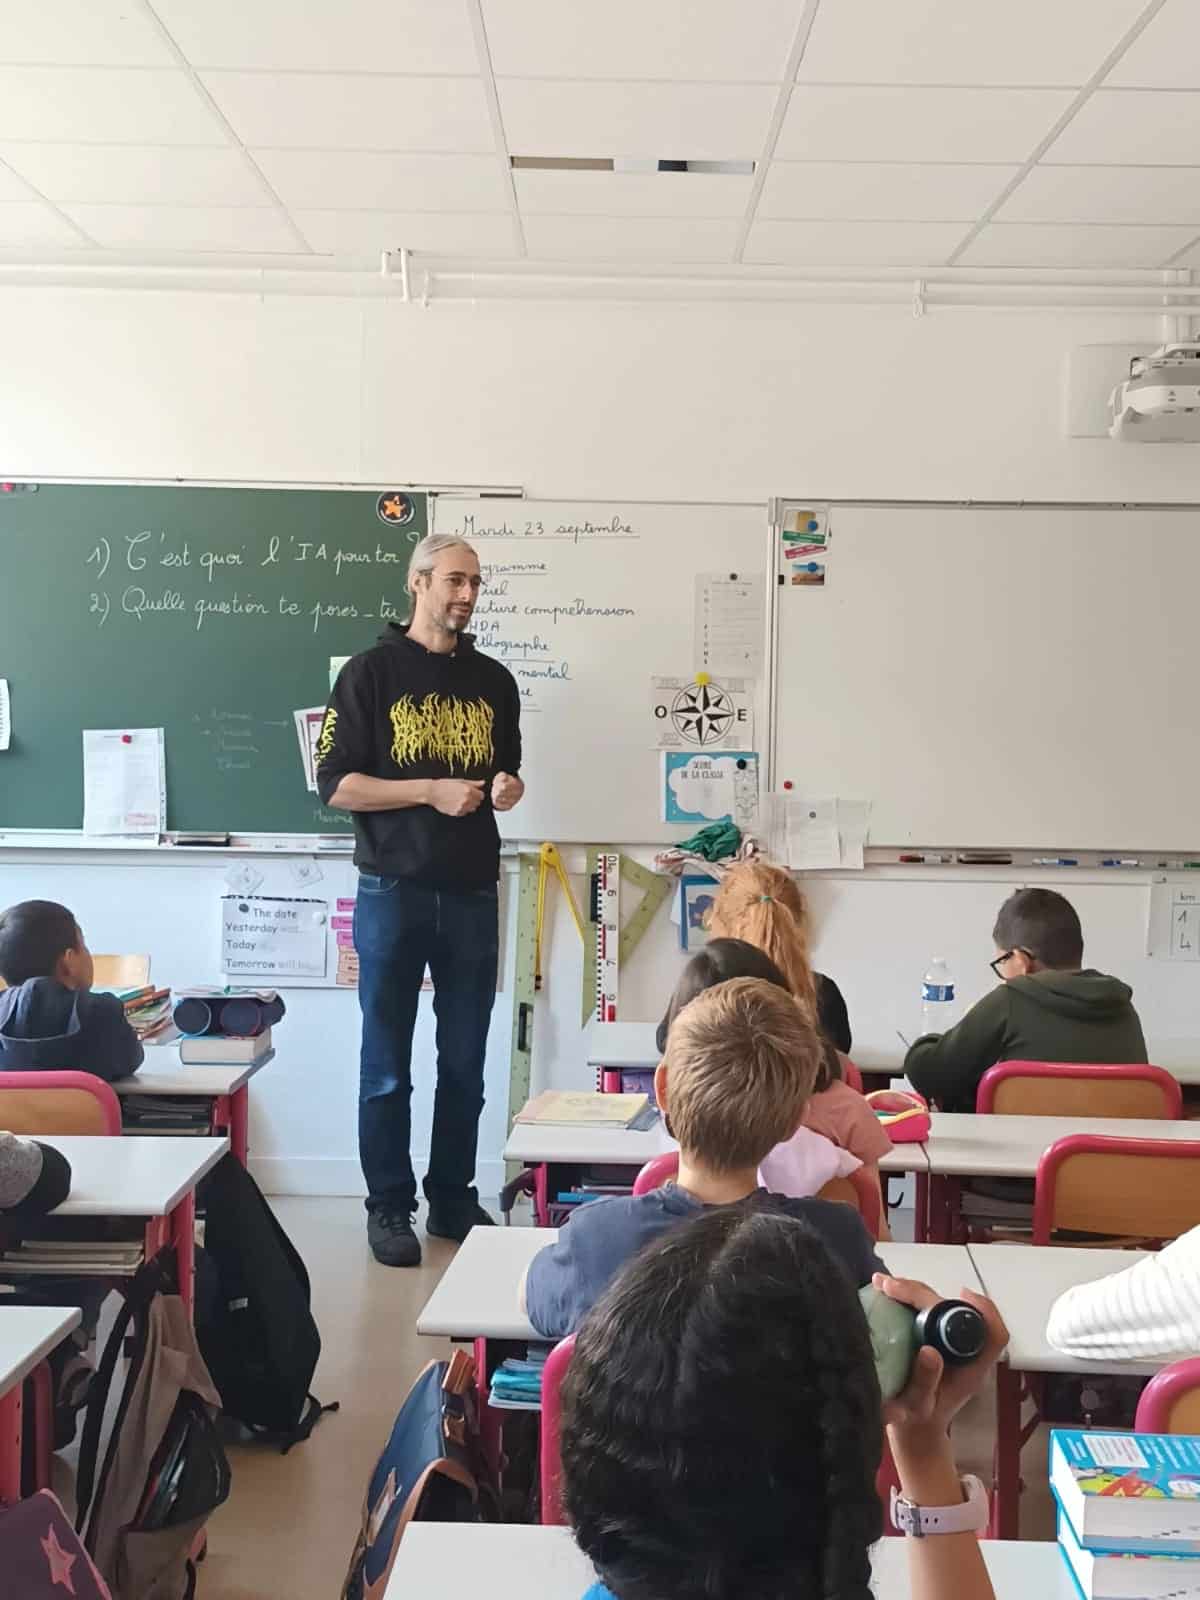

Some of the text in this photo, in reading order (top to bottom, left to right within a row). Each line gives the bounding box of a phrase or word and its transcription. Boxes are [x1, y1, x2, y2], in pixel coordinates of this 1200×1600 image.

[455, 515, 634, 544] Mardi 23 septembre
[87, 537, 110, 579] 1)
[200, 544, 244, 582] quoi
[334, 550, 371, 575] pour
[89, 592, 110, 626] 2)
[122, 586, 186, 621] Quelle
[195, 592, 269, 630] question
[279, 596, 300, 615] te
[475, 600, 518, 614] ecture
[469, 620, 500, 632] HDA
[518, 662, 573, 681] mental
[655, 705, 668, 719] O
[737, 709, 748, 721] E
[1180, 891, 1195, 900] km
[254, 908, 297, 919] The date
[225, 923, 278, 934] Yesterday
[226, 939, 256, 951] Today
[226, 959, 275, 969] Tomorrow
